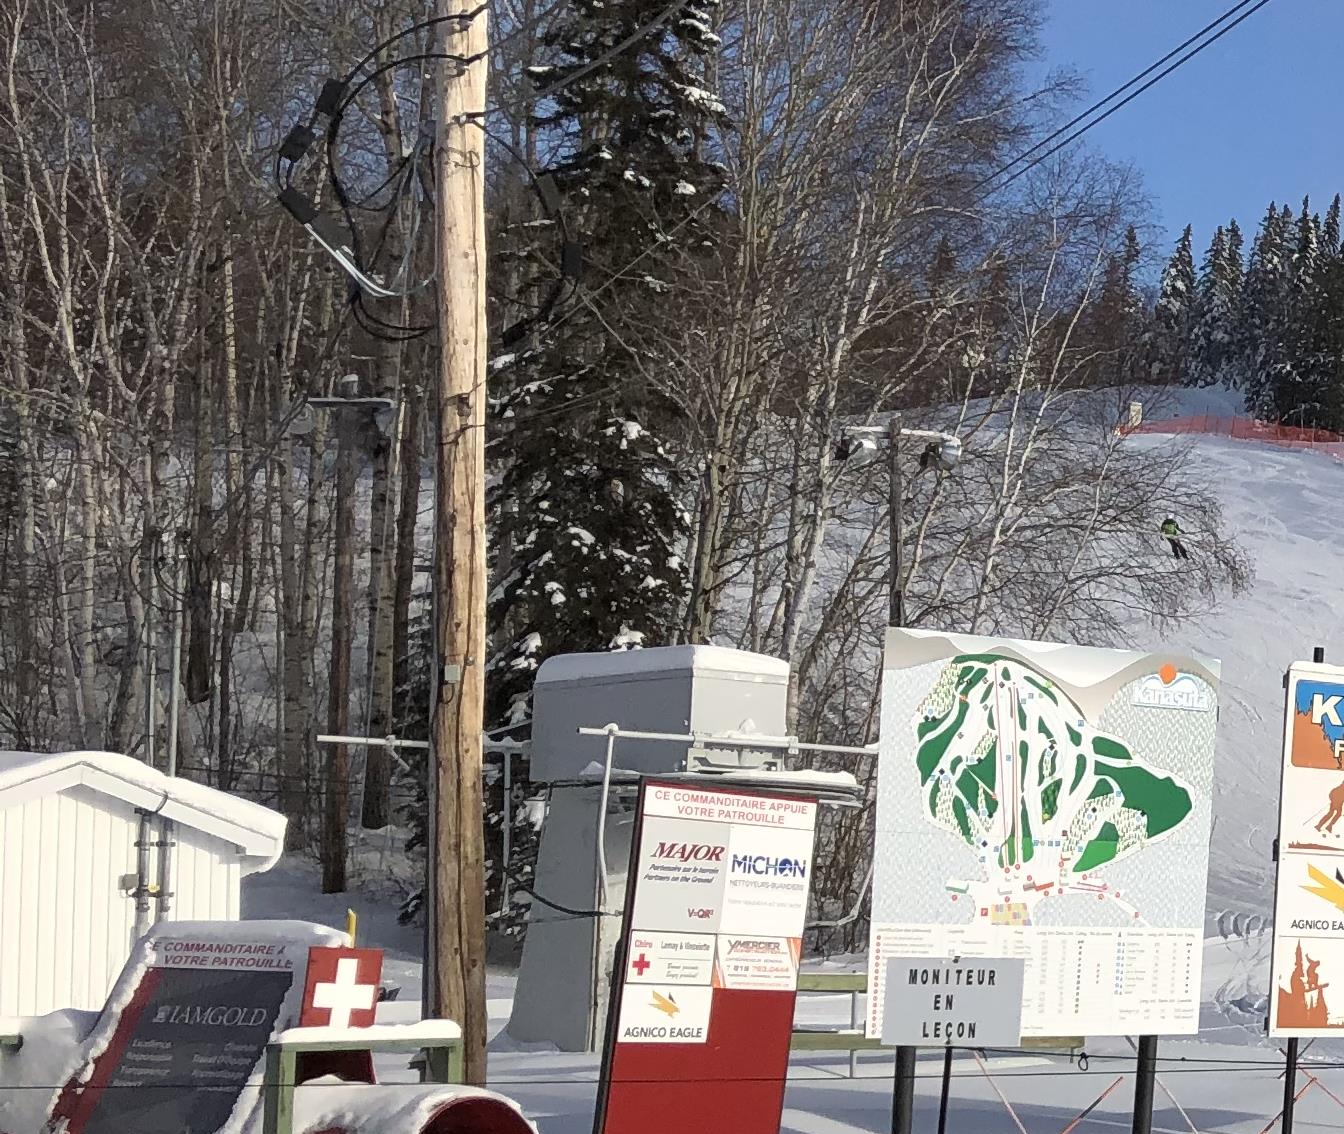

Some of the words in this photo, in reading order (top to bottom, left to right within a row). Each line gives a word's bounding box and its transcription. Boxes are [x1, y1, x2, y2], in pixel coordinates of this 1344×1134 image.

[1133, 687, 1208, 708] Kanasuta
[655, 790, 671, 801] CE
[674, 792, 767, 811] COMMANDITAIRE
[768, 802, 808, 815] APPUIE
[677, 805, 715, 818] VOTRE
[718, 809, 785, 825] PATROUILLE
[650, 841, 725, 863] MAJOR
[731, 853, 806, 878] MICHON
[1290, 918, 1329, 932] AGNICO
[164, 941, 277, 955] COMMANDITAIRE
[164, 955, 210, 966] VOTRE
[211, 956, 293, 969] PATROUILLE
[908, 968, 996, 986] MONITEUR
[933, 994, 954, 1011] EN
[169, 1005, 268, 1027] IAMGOLD
[624, 1026, 667, 1038] AGNICO
[669, 1027, 703, 1039] EAGLE
[922, 1021, 977, 1040] LEÇON
